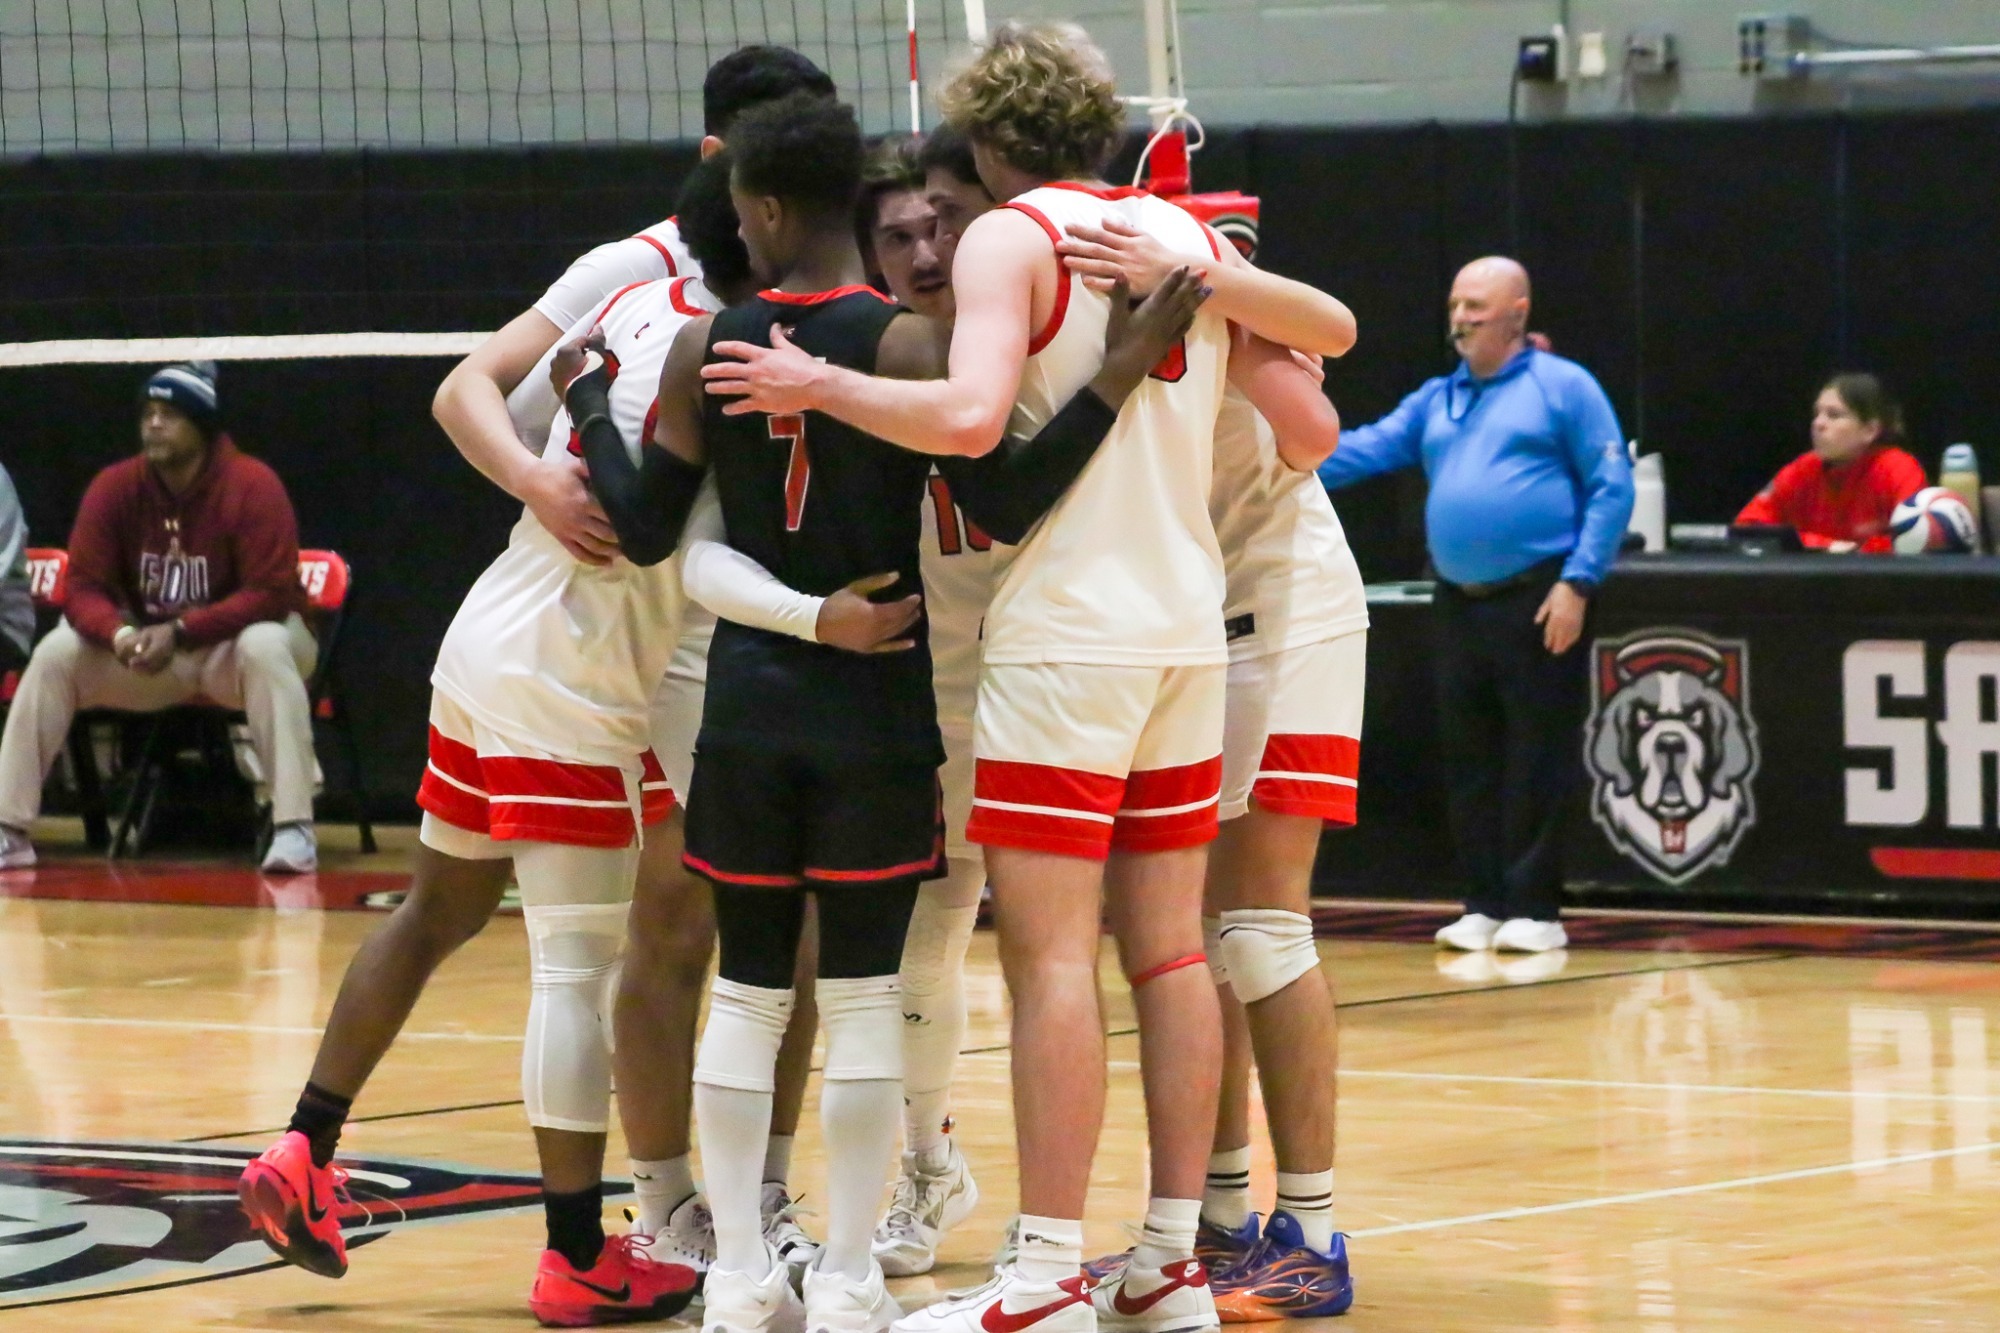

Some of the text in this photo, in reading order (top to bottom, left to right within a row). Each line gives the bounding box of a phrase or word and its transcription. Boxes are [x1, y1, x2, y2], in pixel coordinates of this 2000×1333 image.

[767, 412, 810, 532] 7
[928, 475, 994, 555] 1
[26, 559, 60, 595] TS
[297, 561, 329, 596] TS
